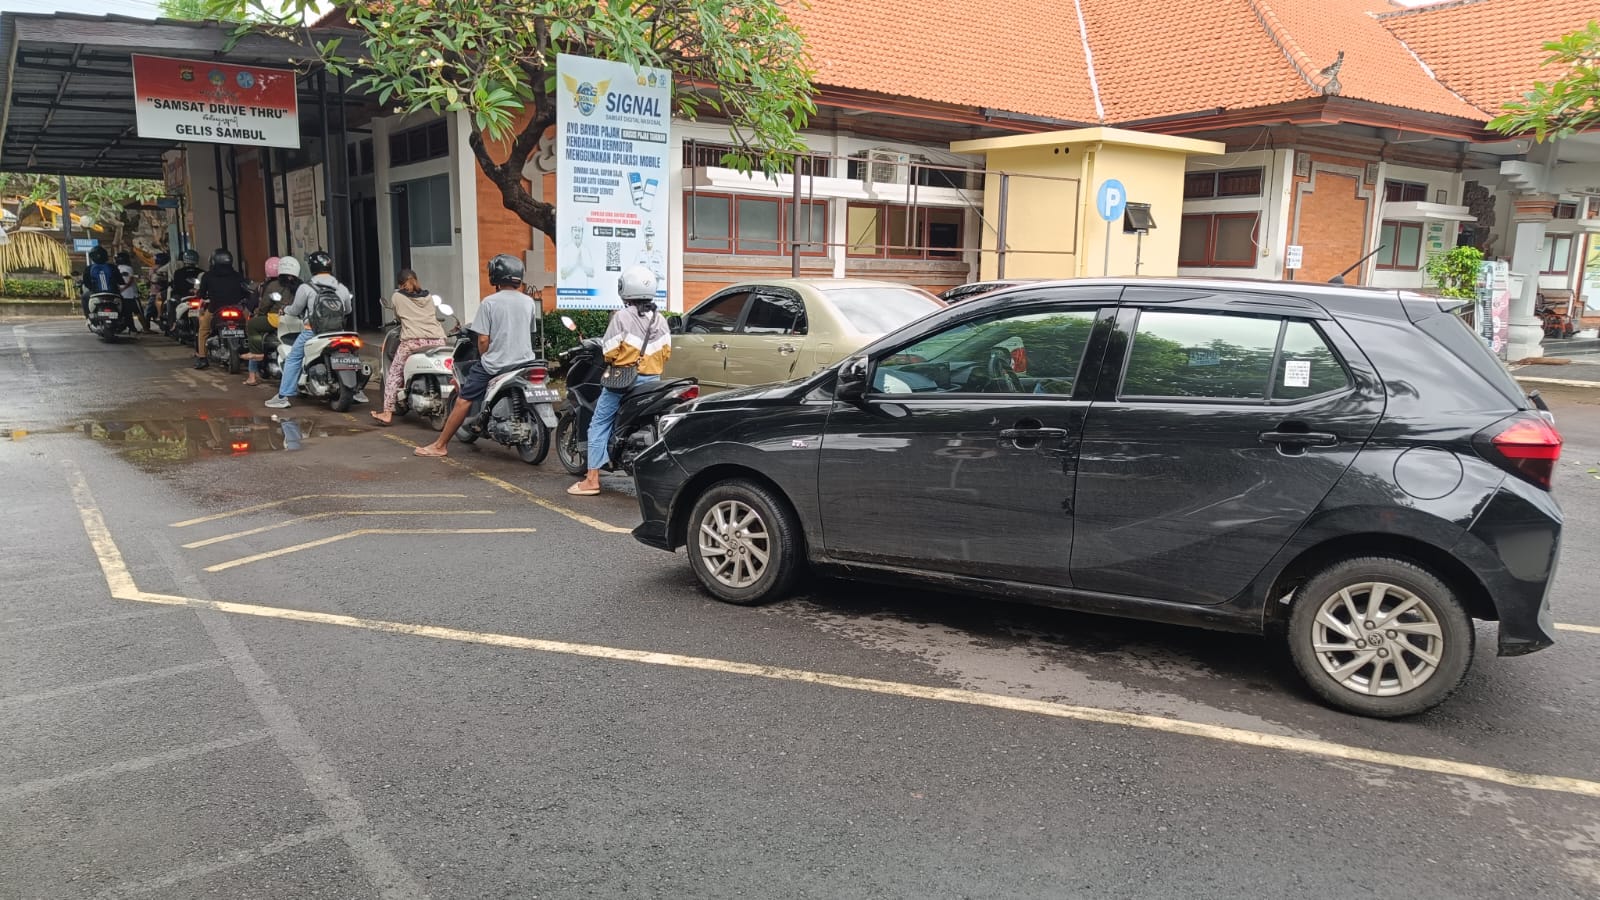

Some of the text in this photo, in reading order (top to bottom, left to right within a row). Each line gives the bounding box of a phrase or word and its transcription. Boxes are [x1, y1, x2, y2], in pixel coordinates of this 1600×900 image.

[147, 97, 288, 119] "SAMSAT DRIVE THRU"
[605, 91, 662, 118] SIGNAL
[175, 124, 267, 141] GELIS SAMBUL
[566, 121, 579, 135] AYO
[580, 123, 600, 137] BAYAR
[600, 125, 620, 139] PAJAK
[566, 135, 633, 153] KENDARAAN BERMOTOR
[565, 148, 661, 168] MENGGUNAKAN APLIKASI MOBILE
[1105, 187, 1121, 217] P
